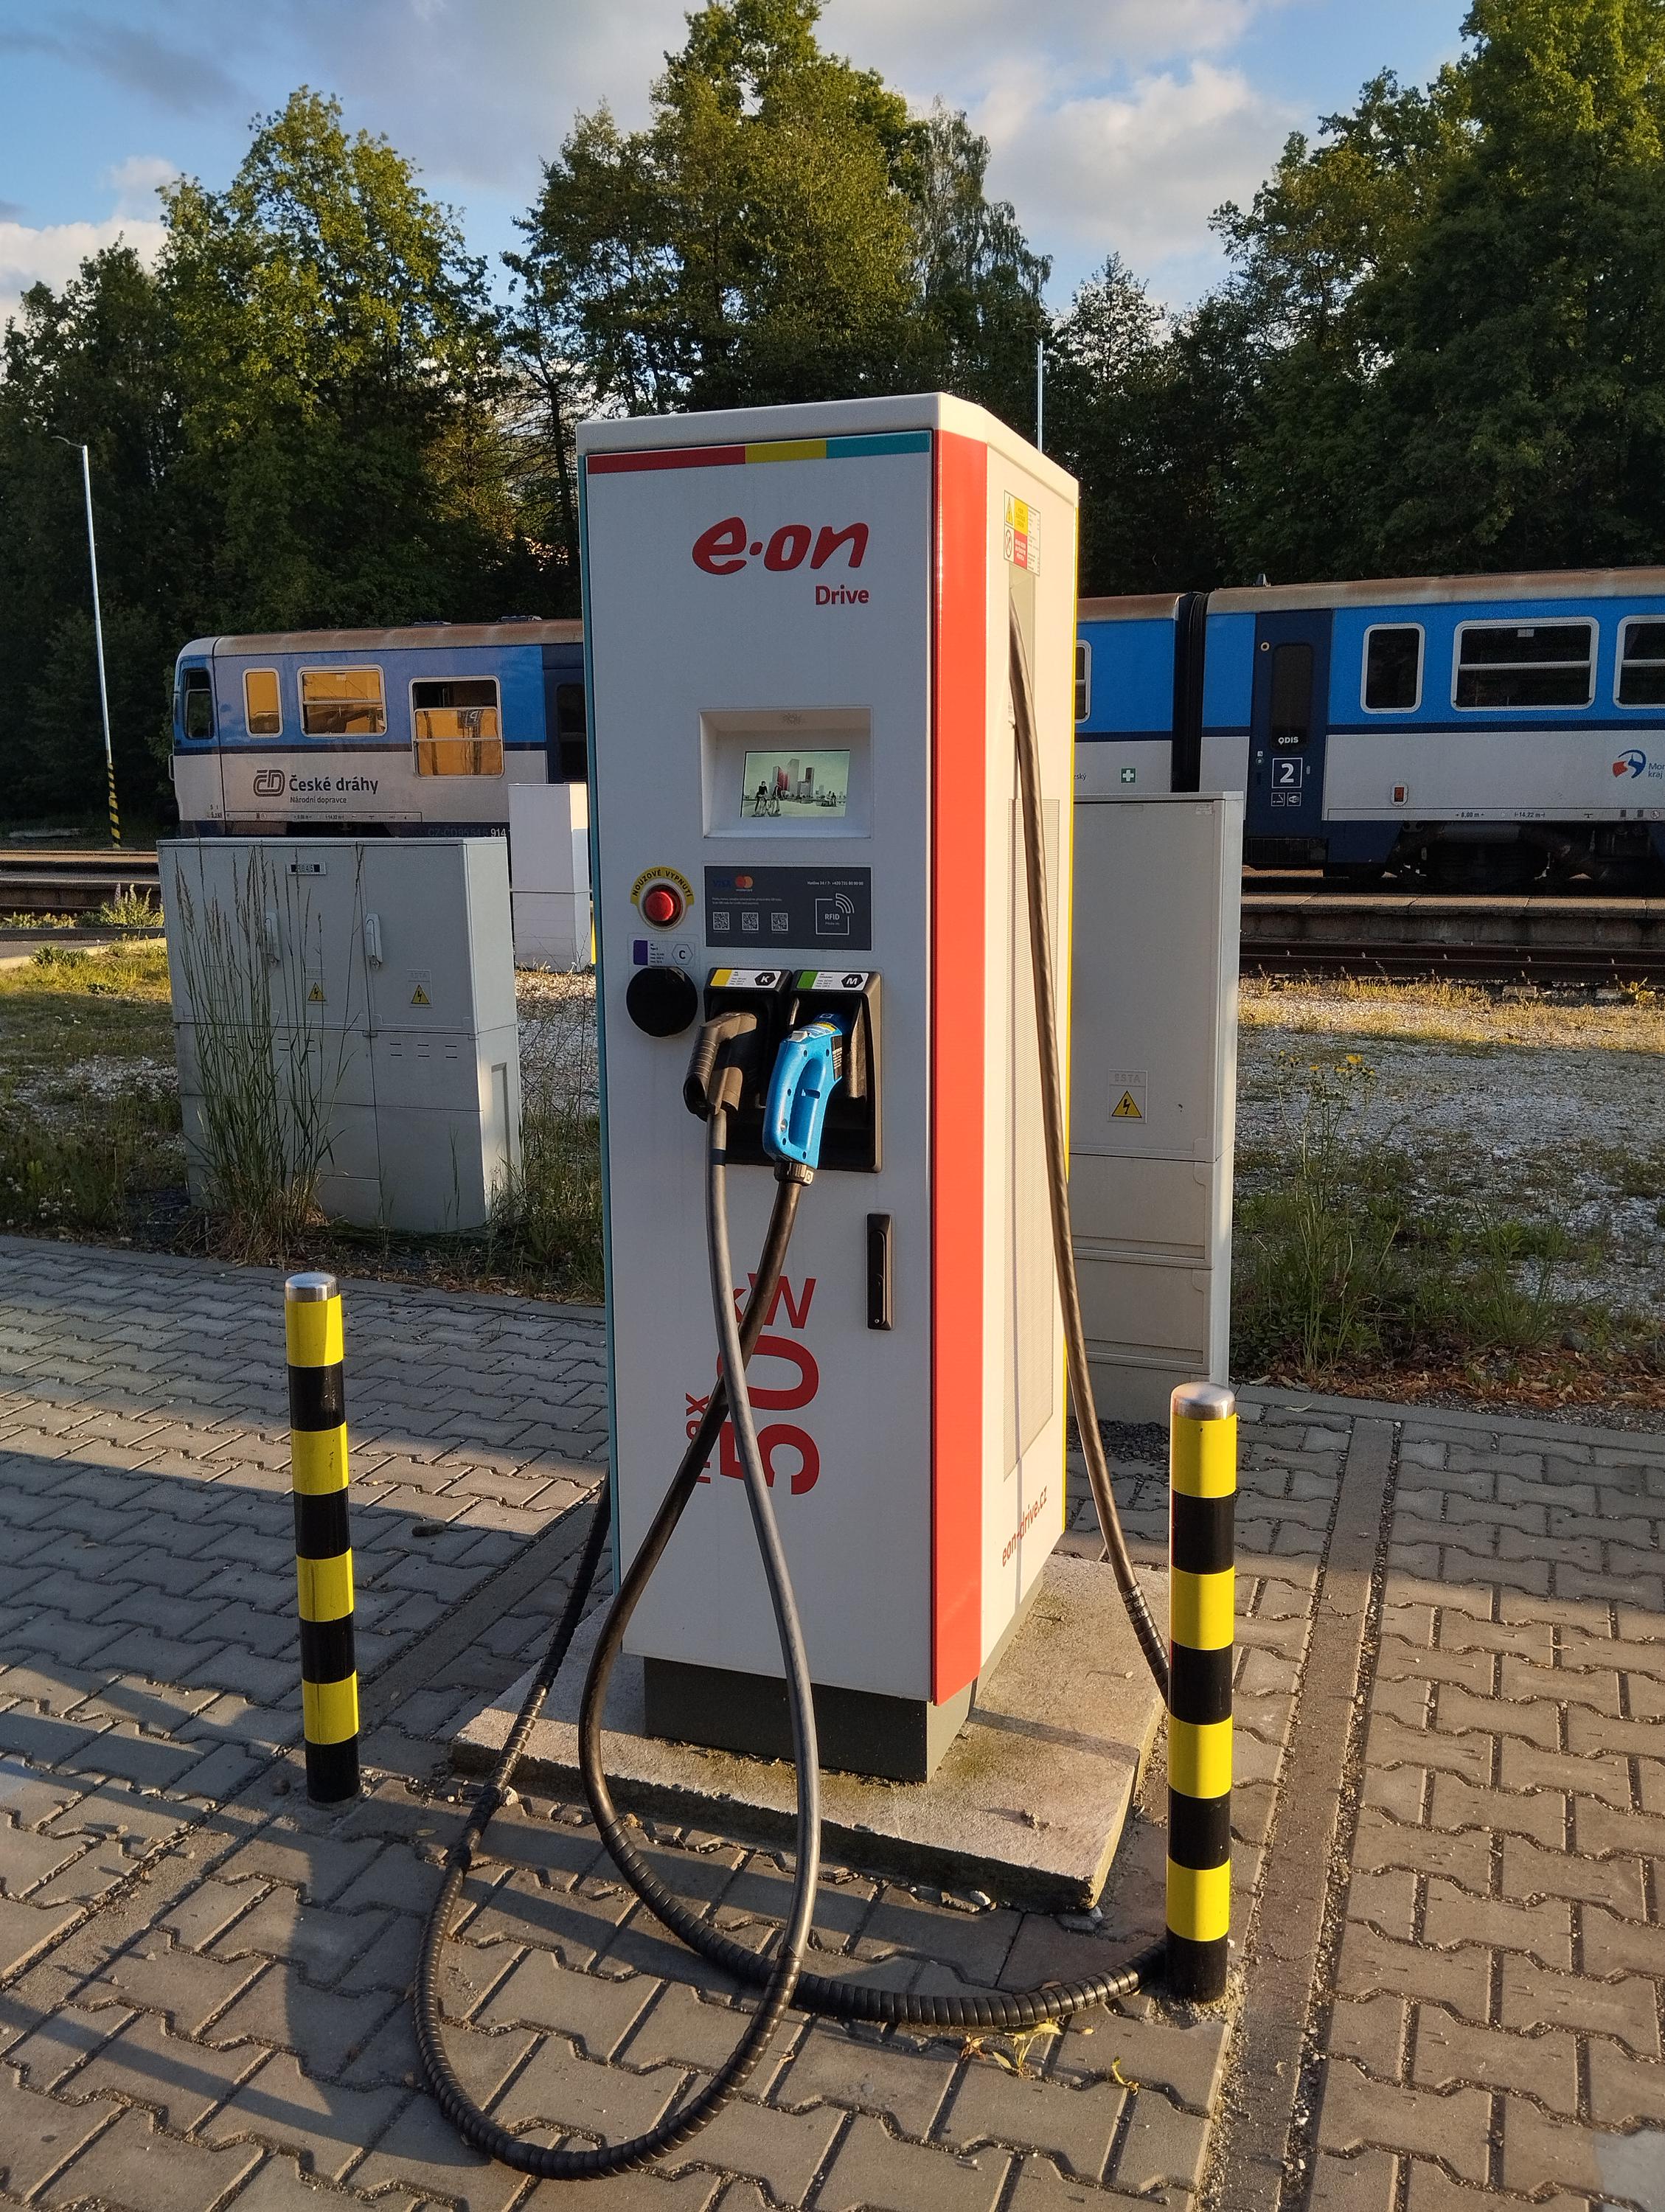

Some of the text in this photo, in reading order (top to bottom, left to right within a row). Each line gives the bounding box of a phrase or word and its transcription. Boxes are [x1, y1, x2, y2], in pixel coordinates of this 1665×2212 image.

[815, 584, 869, 605] Drive
[1279, 762, 1295, 783] 2
[1647, 771, 1663, 779] kraj
[289, 775, 378, 795] České dráhy
[490, 828, 507, 837] 914
[632, 869, 693, 897] NOUZOVÉ VYPNUTÍ
[678, 950, 686, 959] C
[846, 977, 858, 985] M
[685, 1392, 711, 1484] ax
[716, 1334, 820, 1495] 50
[1002, 1485, 1047, 1568] eon-drive.cz
